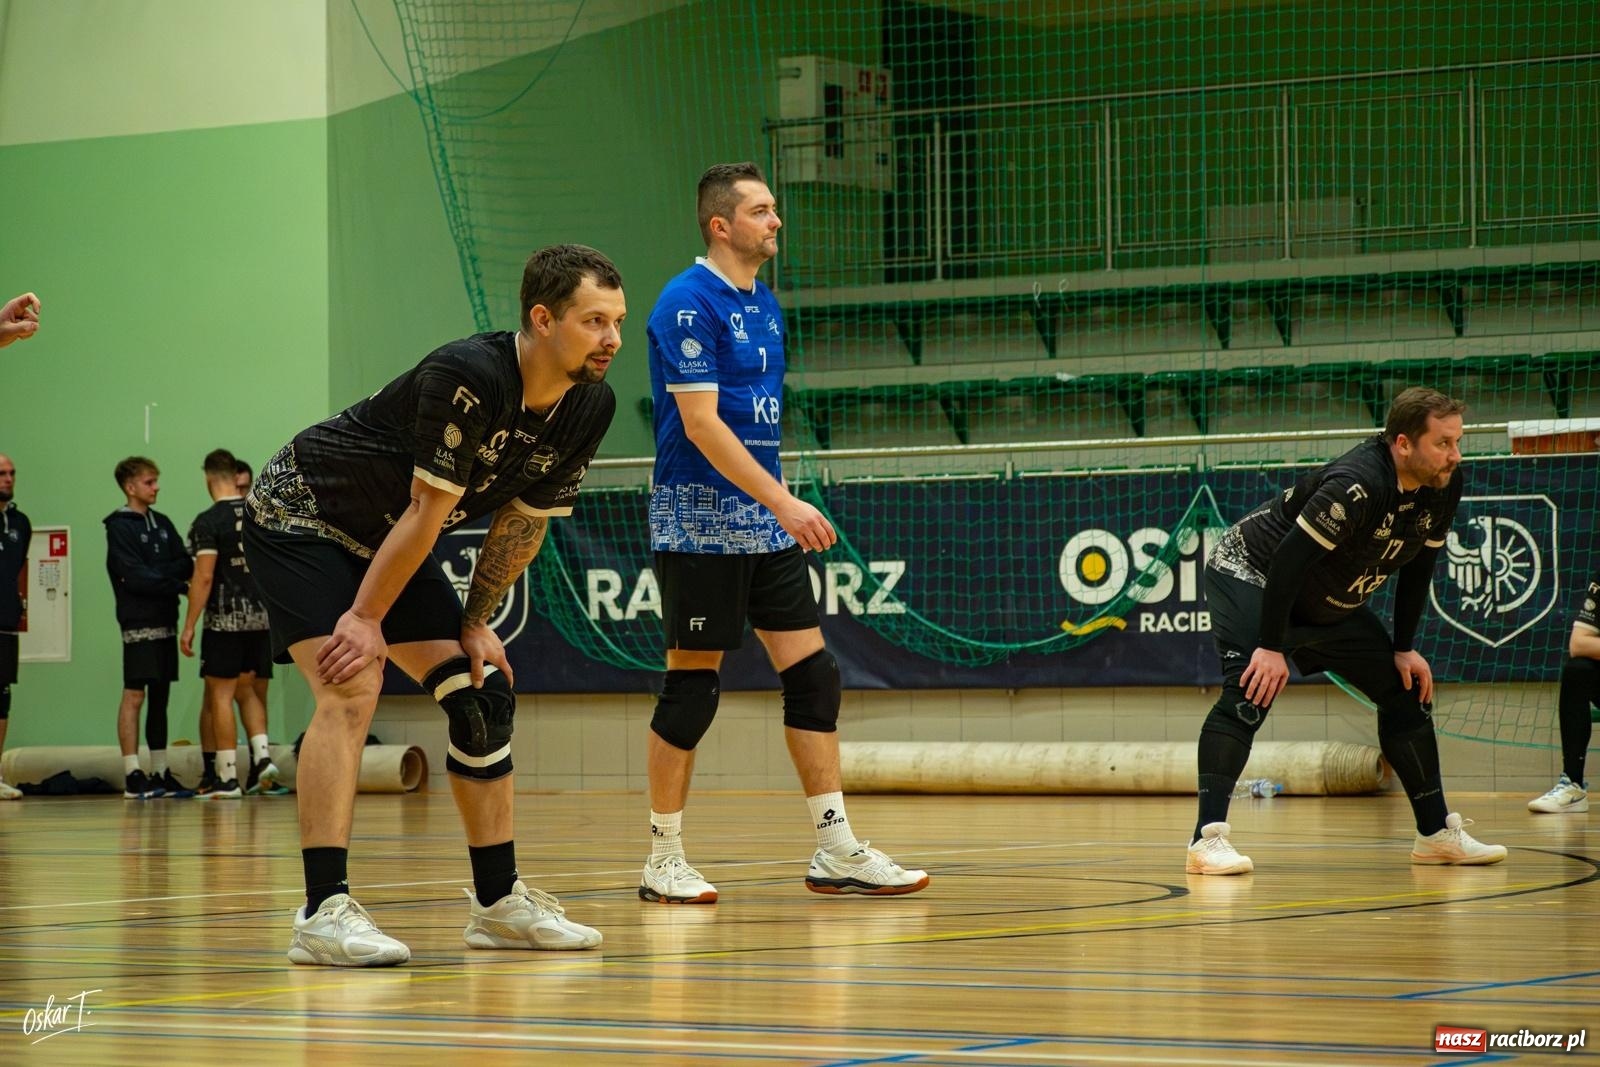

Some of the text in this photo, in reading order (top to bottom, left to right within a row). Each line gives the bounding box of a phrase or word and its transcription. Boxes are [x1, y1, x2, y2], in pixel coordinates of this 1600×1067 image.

[758, 347, 767, 373] 7
[752, 396, 780, 424] KB
[1380, 539, 1404, 560] 17
[1059, 527, 1225, 605] OSi
[1140, 611, 1212, 633] RACIB
[816, 817, 845, 830] LOTTO
